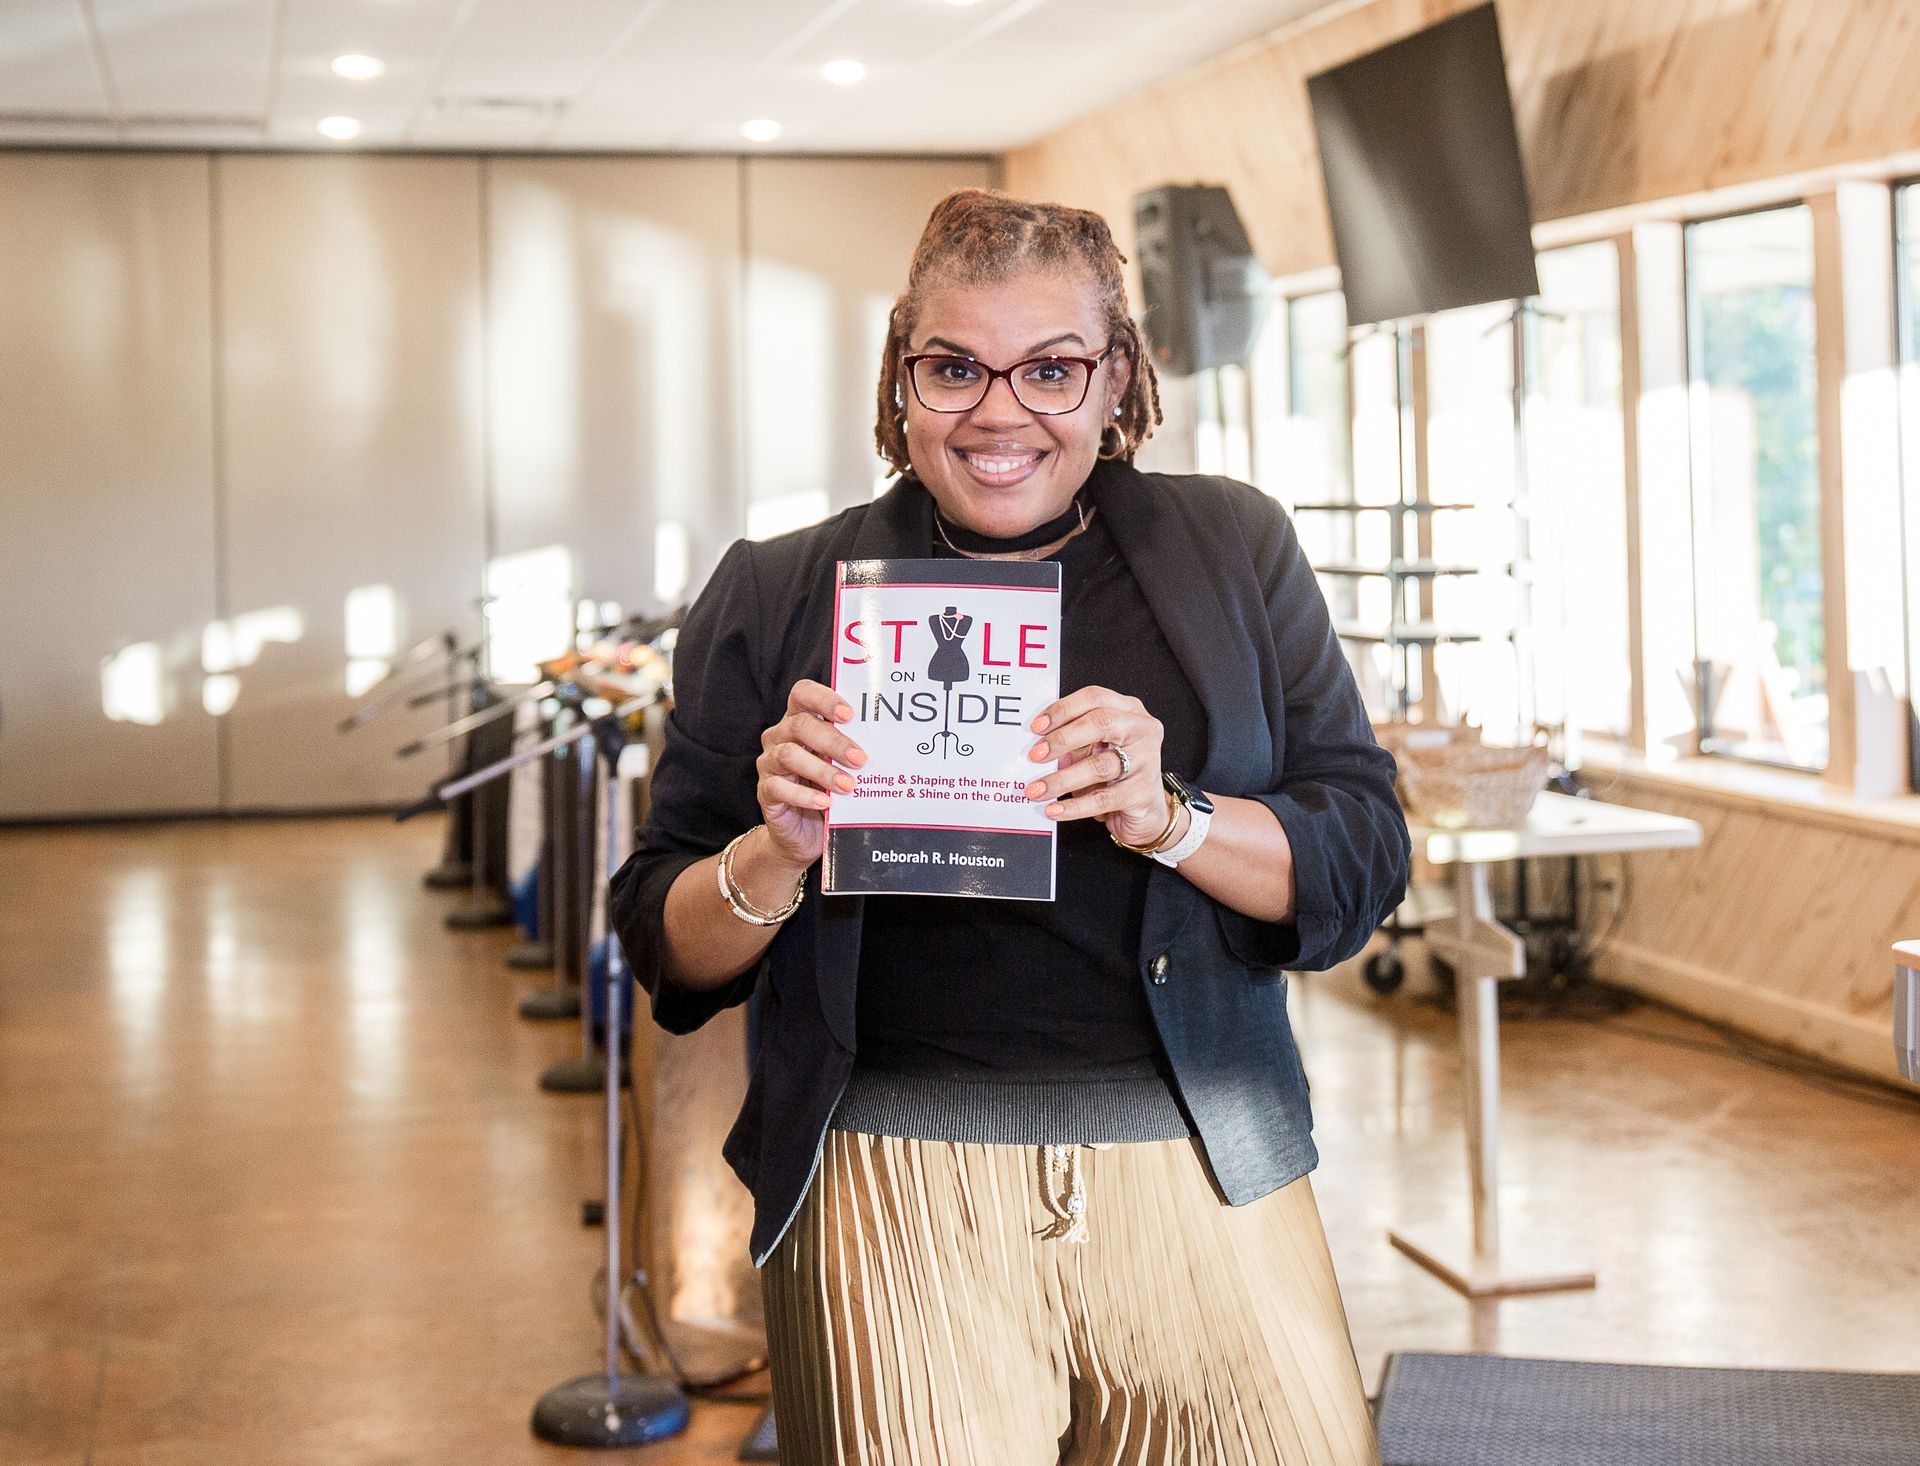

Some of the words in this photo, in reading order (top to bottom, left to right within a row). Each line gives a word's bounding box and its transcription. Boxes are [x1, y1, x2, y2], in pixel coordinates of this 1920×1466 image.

[890, 671, 915, 682] ON
[977, 673, 1011, 686] THE
[861, 692, 1022, 726] INSIDE
[857, 774, 894, 786] Suiting
[898, 774, 907, 784] &
[910, 775, 955, 788] Shaping
[959, 777, 977, 787] the
[981, 778, 1010, 789] Inner
[1014, 780, 1025, 789] to
[853, 788, 903, 798] Shimmer
[907, 788, 915, 798] &
[919, 789, 950, 799] Shine
[954, 792, 968, 800] on
[972, 791, 990, 801] the
[872, 850, 928, 863] Deborah
[932, 852, 945, 864] R.
[949, 853, 1005, 867] Houston
